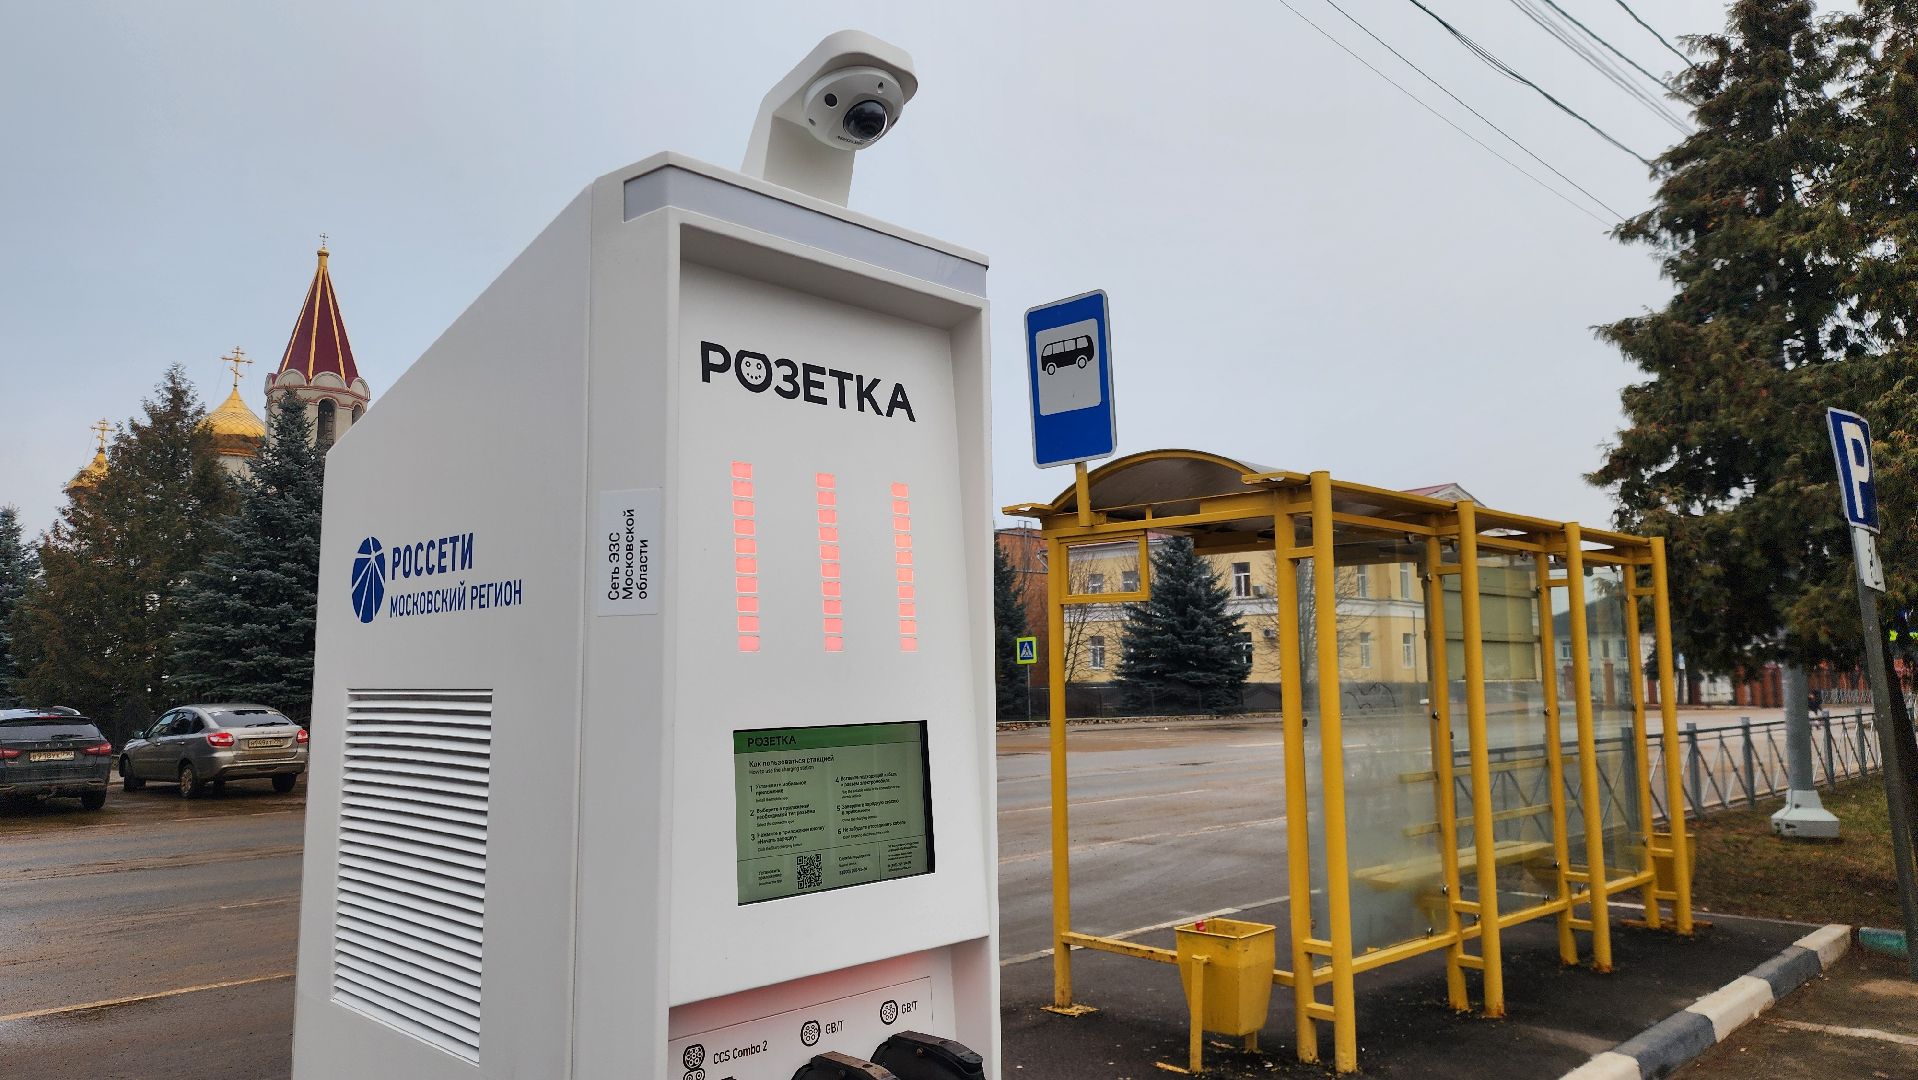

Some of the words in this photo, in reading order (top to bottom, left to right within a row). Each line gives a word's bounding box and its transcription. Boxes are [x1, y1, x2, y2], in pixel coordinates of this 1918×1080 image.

[701, 341, 917, 422] РОЗЕТКА
[1841, 421, 1870, 519] P
[392, 533, 474, 580] РОССЕТИ
[609, 532, 620, 563] ЭЗС
[622, 509, 635, 599] Московской
[608, 567, 620, 600] Сеть
[636, 540, 648, 599] области
[390, 581, 467, 618] МОСКОВСКИЙ
[471, 579, 522, 610] РЕГИОН
[747, 736, 797, 747] РОЗЕТКА
[901, 1001, 918, 1015] GB/T
[825, 1019, 844, 1035] GB/T
[713, 1049, 731, 1064] CCS
[732, 1043, 761, 1060] Combo
[762, 1040, 768, 1052] 2
